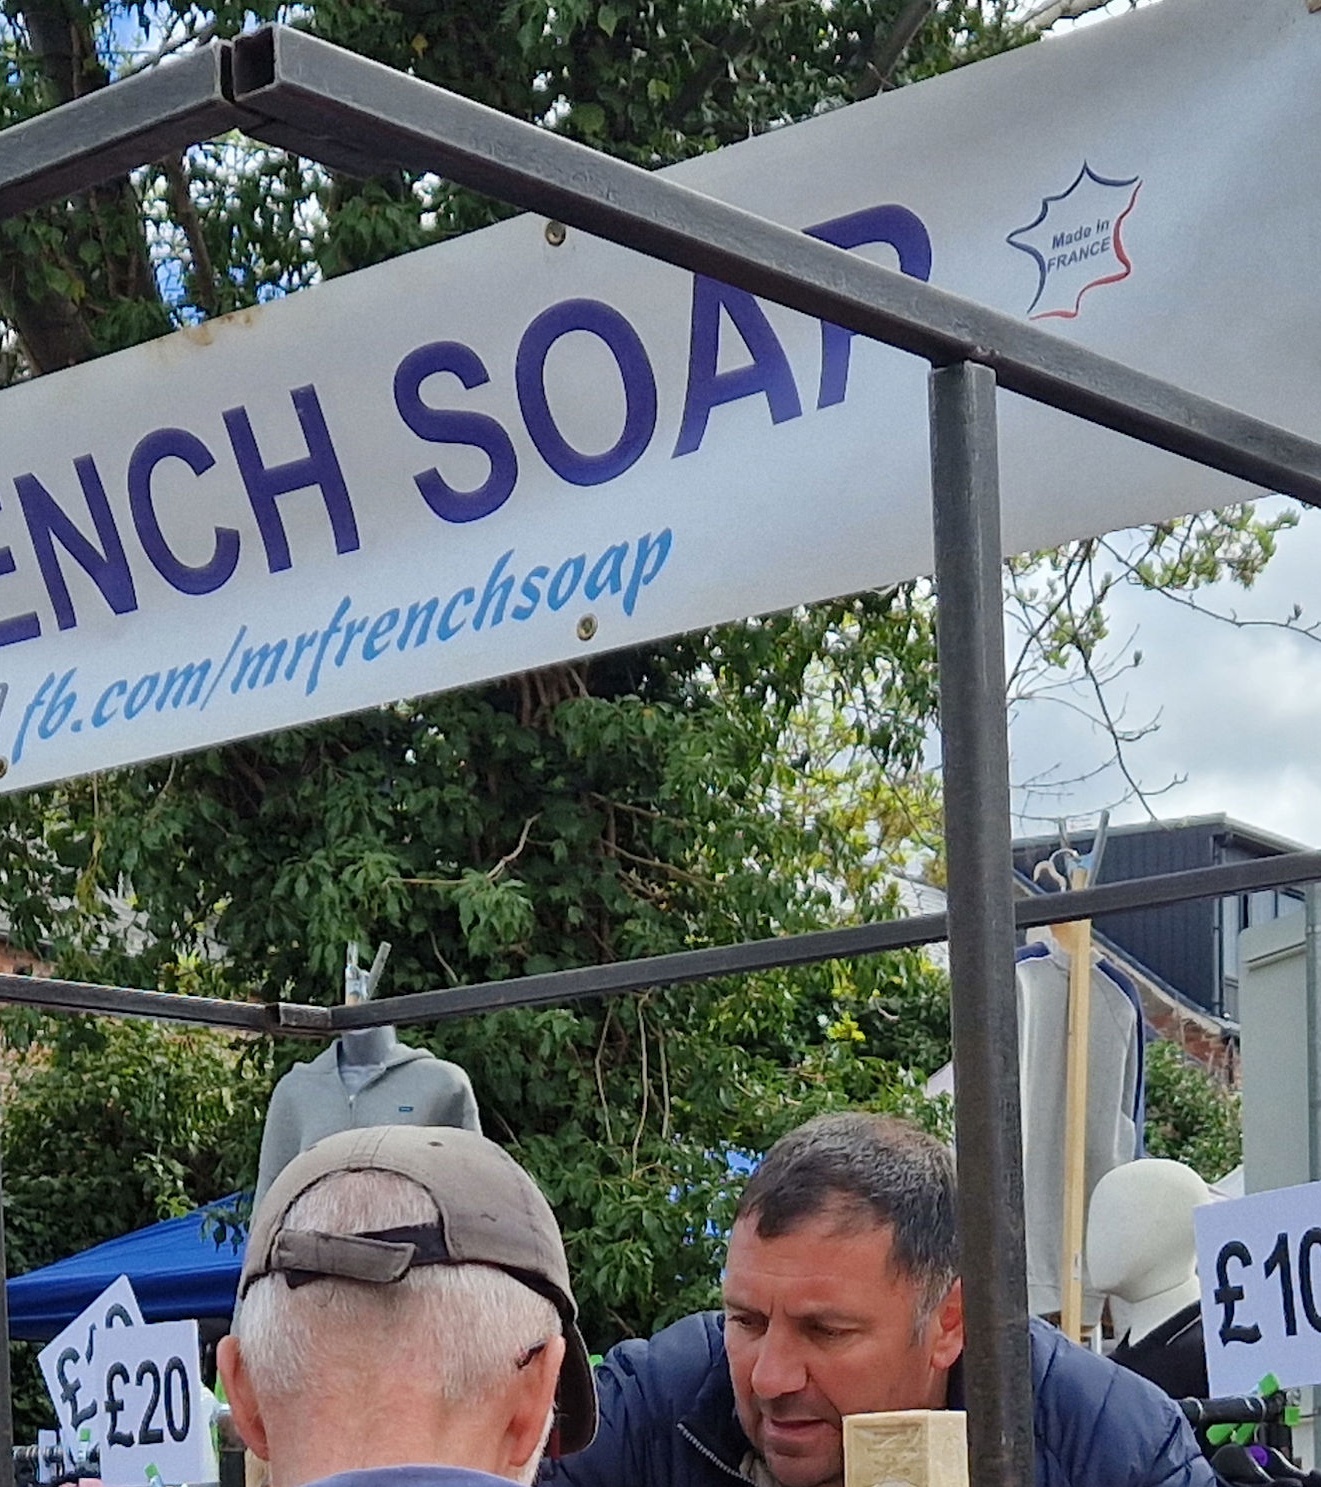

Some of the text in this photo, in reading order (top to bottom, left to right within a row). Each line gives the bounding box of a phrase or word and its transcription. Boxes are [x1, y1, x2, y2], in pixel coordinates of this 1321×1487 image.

[1046, 236, 1111, 273] FRANCE
[1051, 225, 1092, 250] Made
[393, 203, 933, 524] SOAP
[11, 527, 674, 765] fb.com/mrfrenchsoap
[104, 1355, 191, 1449] £20
